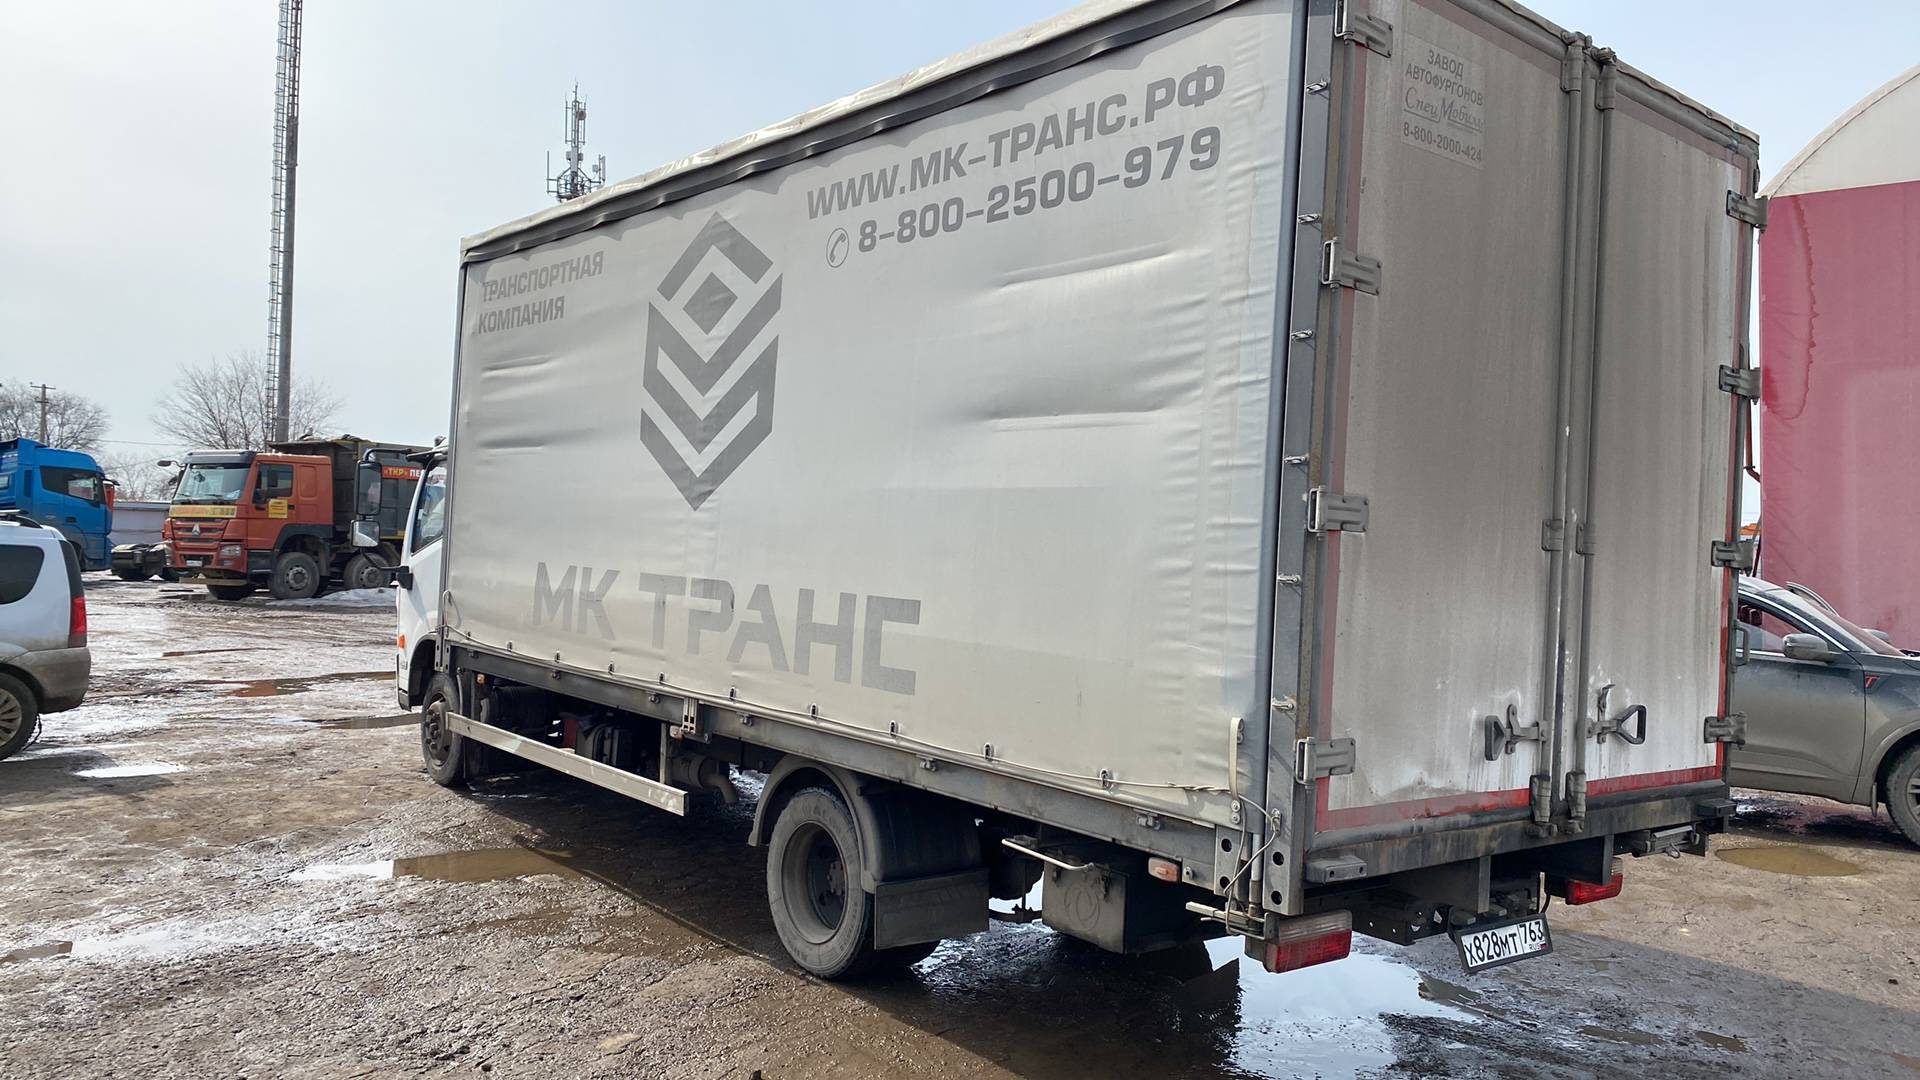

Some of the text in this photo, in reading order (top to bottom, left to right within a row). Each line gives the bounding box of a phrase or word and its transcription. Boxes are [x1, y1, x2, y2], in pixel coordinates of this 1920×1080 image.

[1405, 63, 1484, 106] АВТОФУРГОНОВ
[1427, 49, 1464, 80] ЗАВОД
[1403, 121, 1482, 161] 8-800-2000-424
[858, 126, 1221, 252] 8-800-2500-979
[482, 250, 604, 302] ТРАНСПОРТНАЯ
[478, 296, 565, 335] КОМПАНИЯ
[532, 561, 921, 696] МК ТРАНС
[1519, 920, 1544, 944] 763
